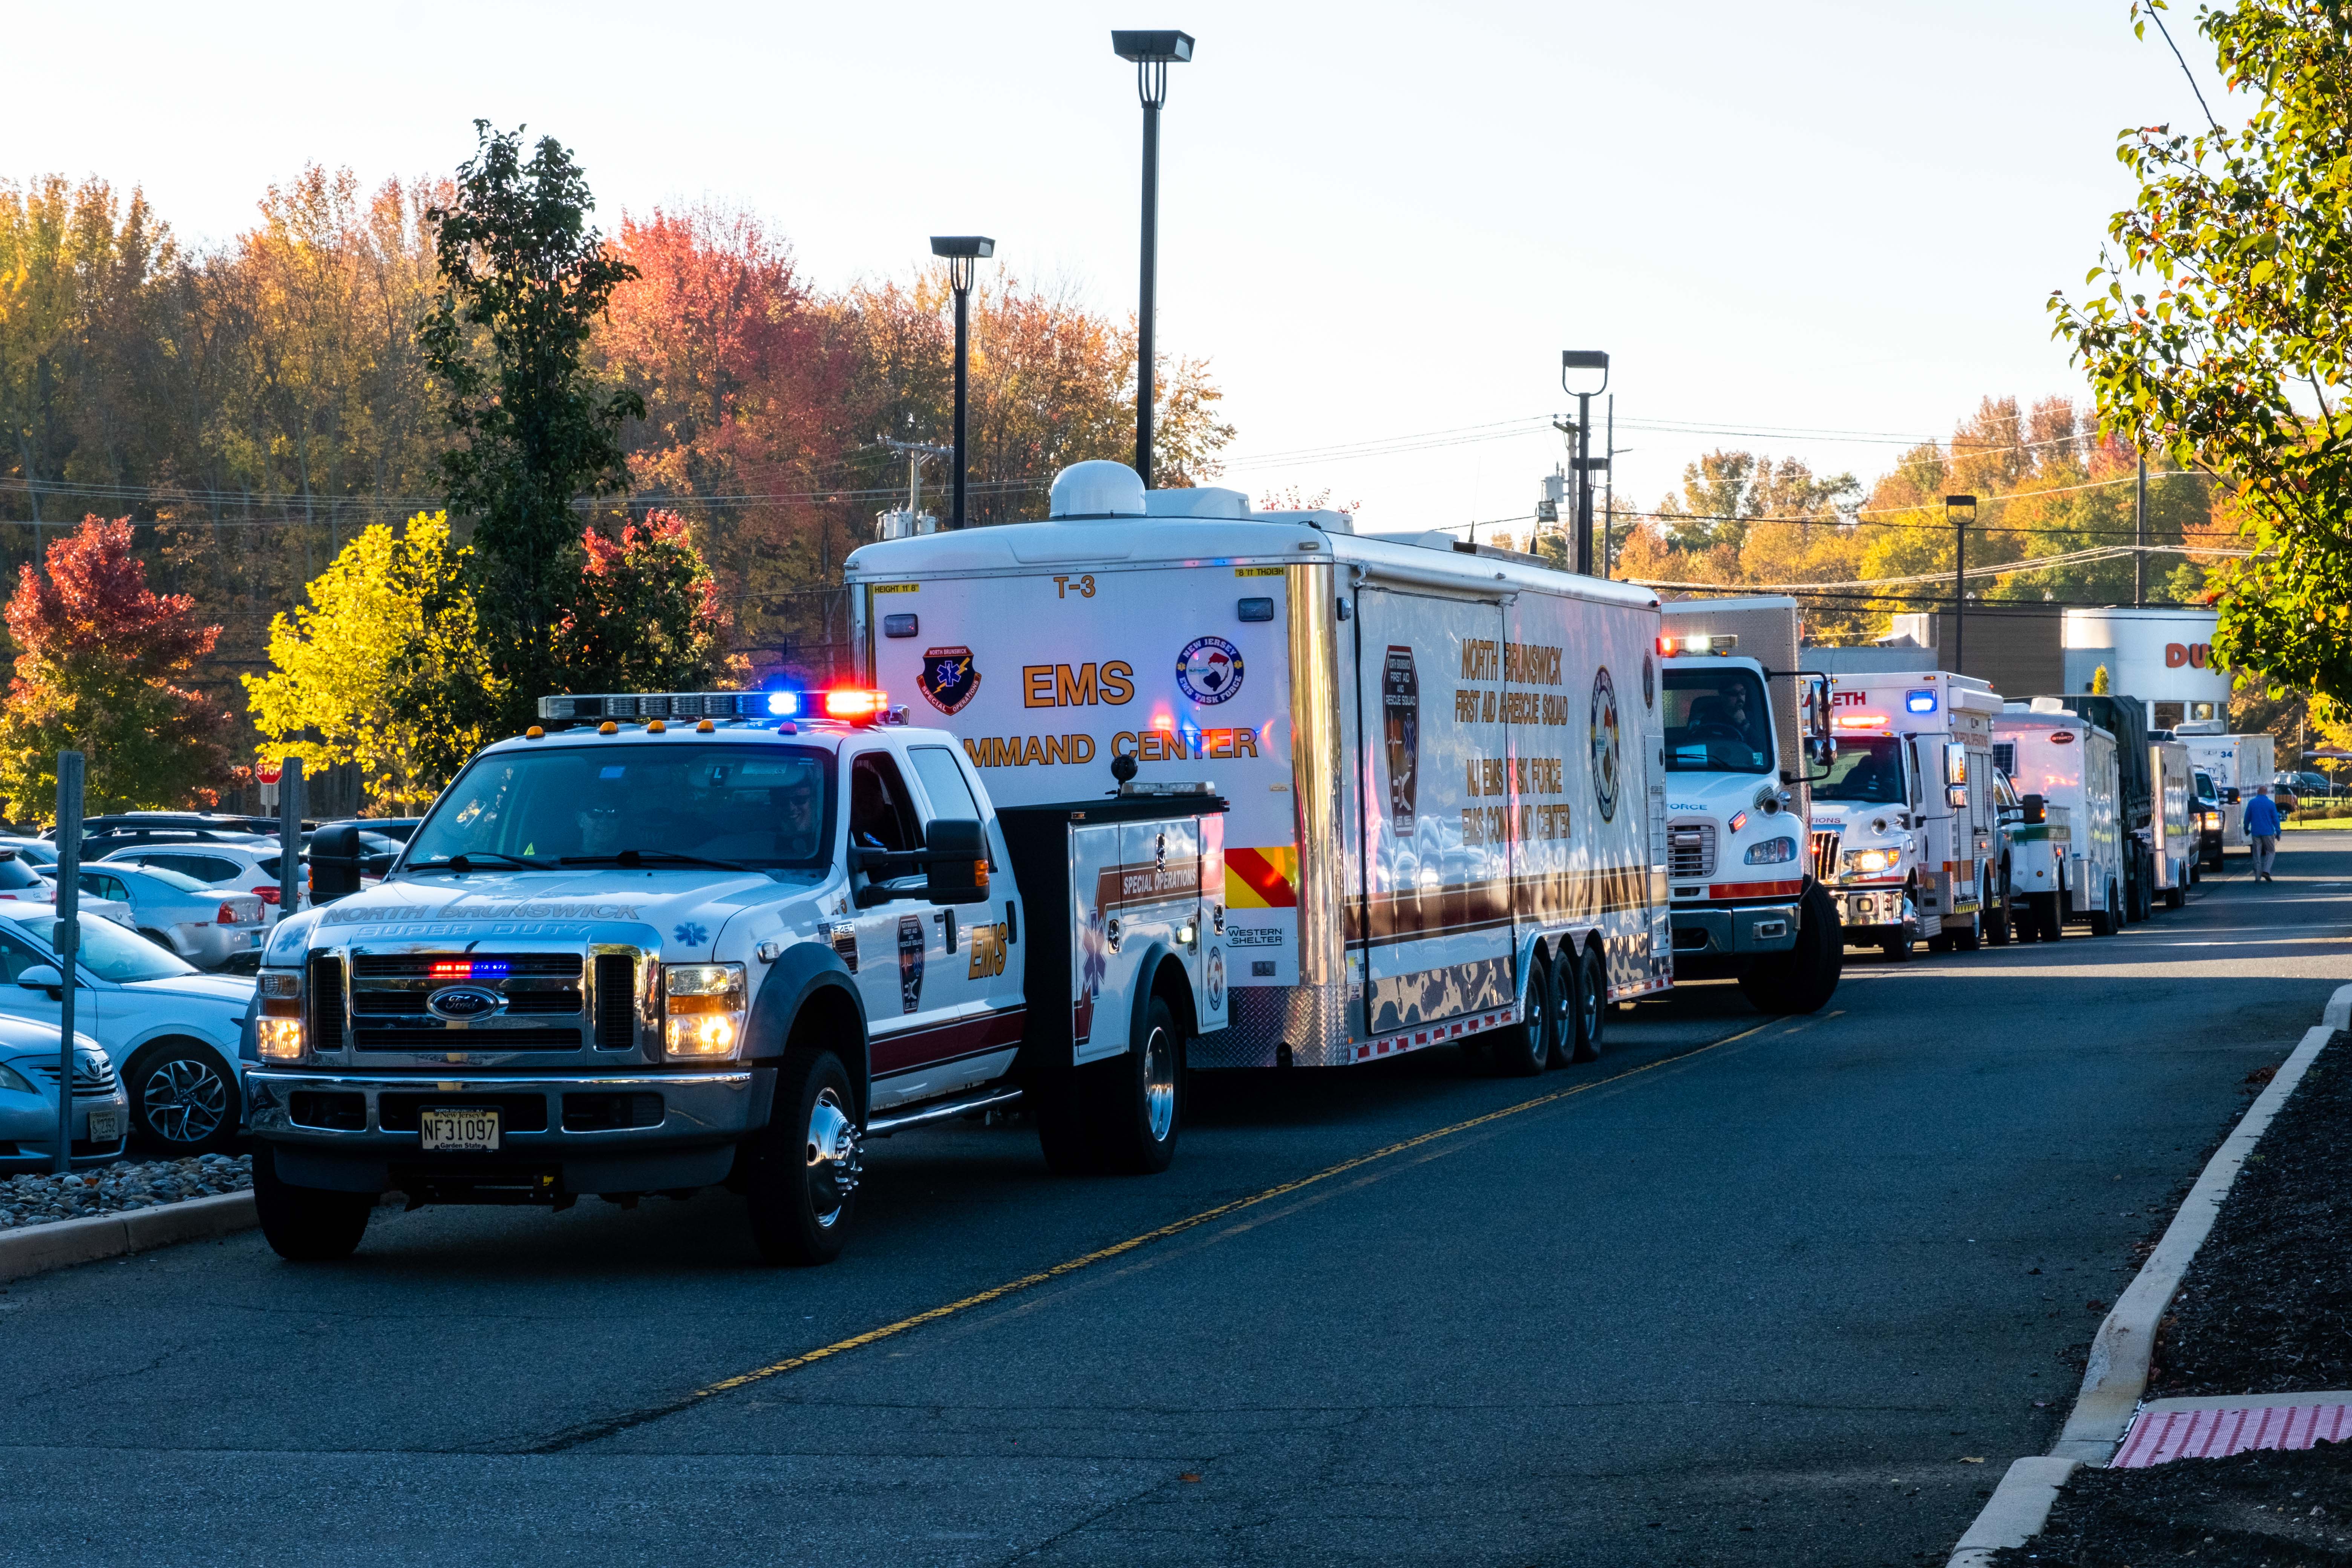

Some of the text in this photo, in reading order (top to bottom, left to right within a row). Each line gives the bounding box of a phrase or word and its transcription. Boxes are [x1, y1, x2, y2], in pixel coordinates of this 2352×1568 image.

[1054, 575, 1096, 599] T-3
[1183, 639, 1237, 658] NEW JERSEY
[1462, 639, 1563, 686] NORTH BRUNSWICK
[1023, 660, 1135, 708] EMS
[1179, 675, 1242, 704] EMS TASK FORCE
[1390, 672, 1401, 682] FIRST
[921, 686, 947, 712] SPECIAL
[952, 680, 978, 712] OPERATIONS
[1386, 695, 1416, 706] RESCUE SQUAD
[1455, 690, 1568, 725] FIRST AID & RESCUE SQUAD
[963, 727, 1259, 768] MMAND CENTER
[1467, 757, 1562, 797] NJ EMS TASK FORCE
[1462, 807, 1484, 846] EMS
[1536, 804, 1571, 841] CENTER
[1124, 868, 1196, 895] SPECIAL OPERATIONS
[322, 904, 647, 924] NORTH BRUNSWICK
[357, 923, 592, 937] SUPER DUTY
[968, 922, 1008, 980] EMS
[446, 995, 477, 1009] Ford
[424, 1119, 495, 1141] NF31097
